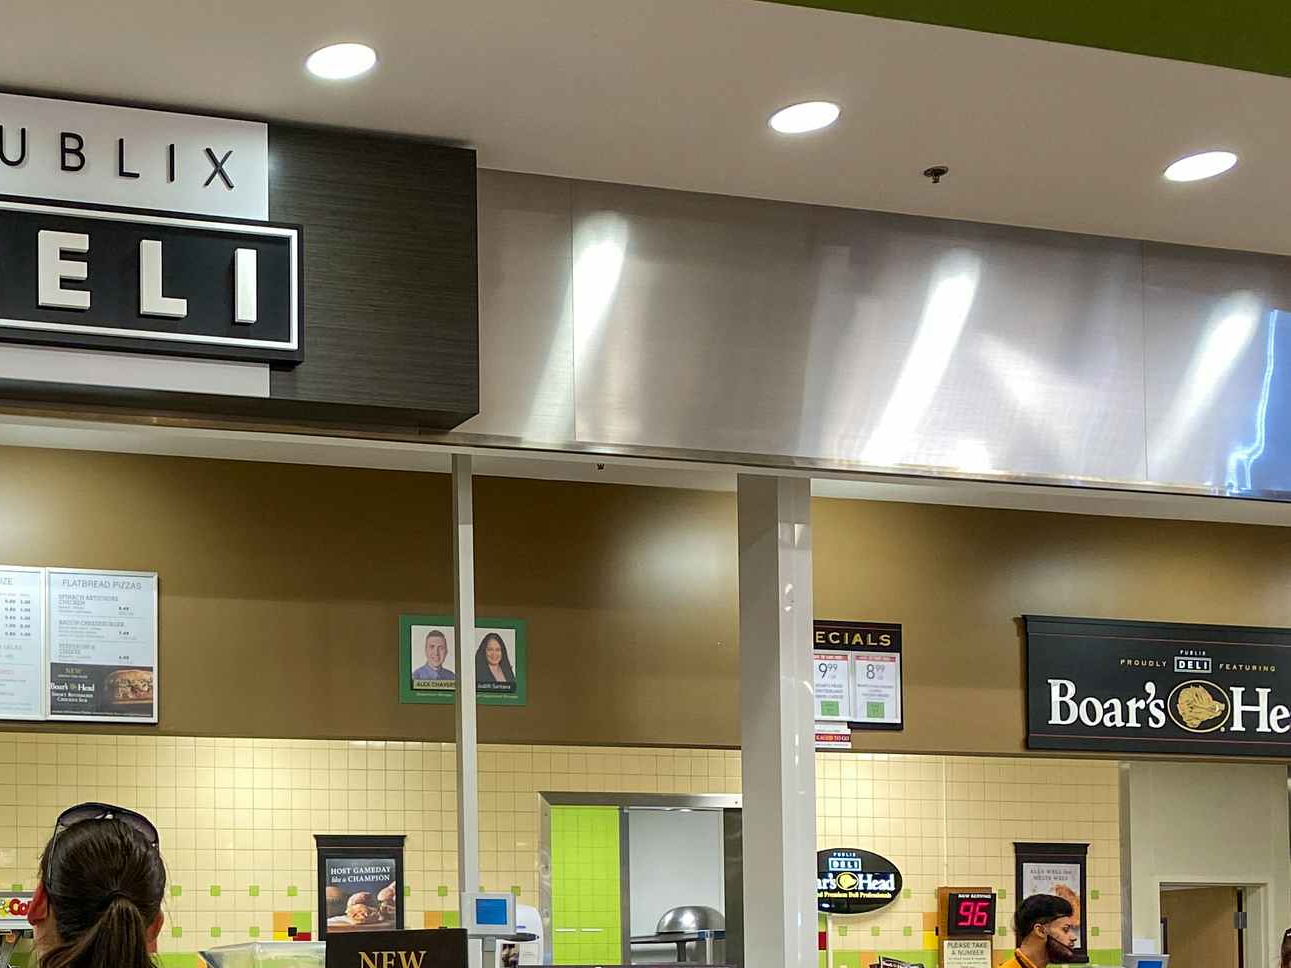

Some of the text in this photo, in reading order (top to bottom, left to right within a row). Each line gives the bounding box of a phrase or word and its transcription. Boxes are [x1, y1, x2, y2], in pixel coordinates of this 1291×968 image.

[62, 579, 143, 590] FLATBREAD PIZZAS
[815, 630, 891, 647] ECIALS
[1120, 659, 1167, 668] PROUDLY
[1178, 660, 1208, 671] DELI
[1219, 663, 1276, 672] FEATURING
[1047, 678, 1166, 729] Boar's
[330, 866, 391, 875] HOST GAMEDAY
[347, 874, 390, 883] CHAMPION
[857, 873, 895, 891] Head
[957, 902, 990, 926] 96
